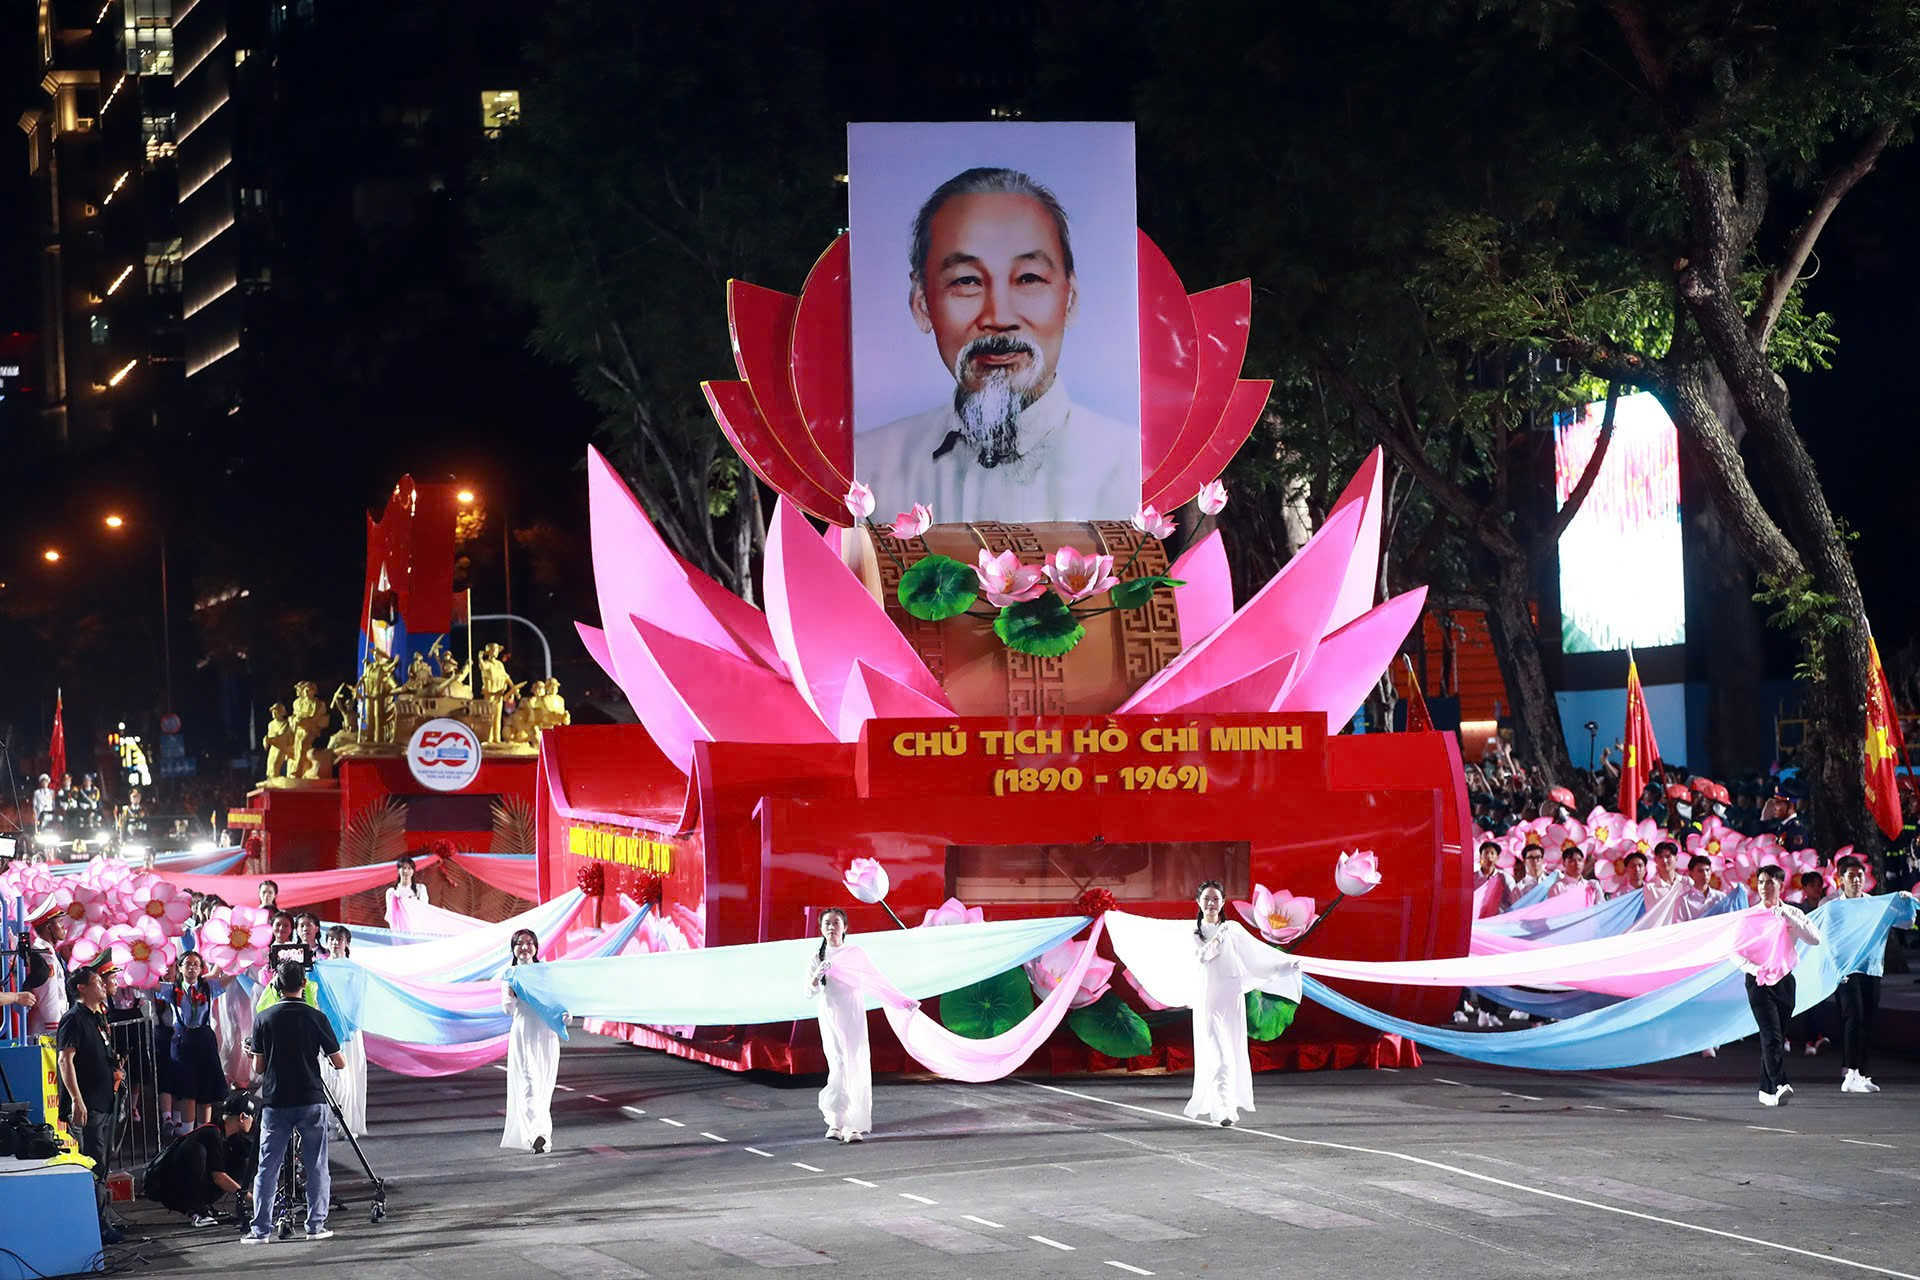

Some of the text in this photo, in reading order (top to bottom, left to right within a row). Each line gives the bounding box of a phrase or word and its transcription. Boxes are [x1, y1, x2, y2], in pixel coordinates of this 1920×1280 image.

[893, 717, 1303, 760] CHỦ TỊCH HỒ CHÍ MINH
[994, 765, 1208, 796] (1890 - 1969)
